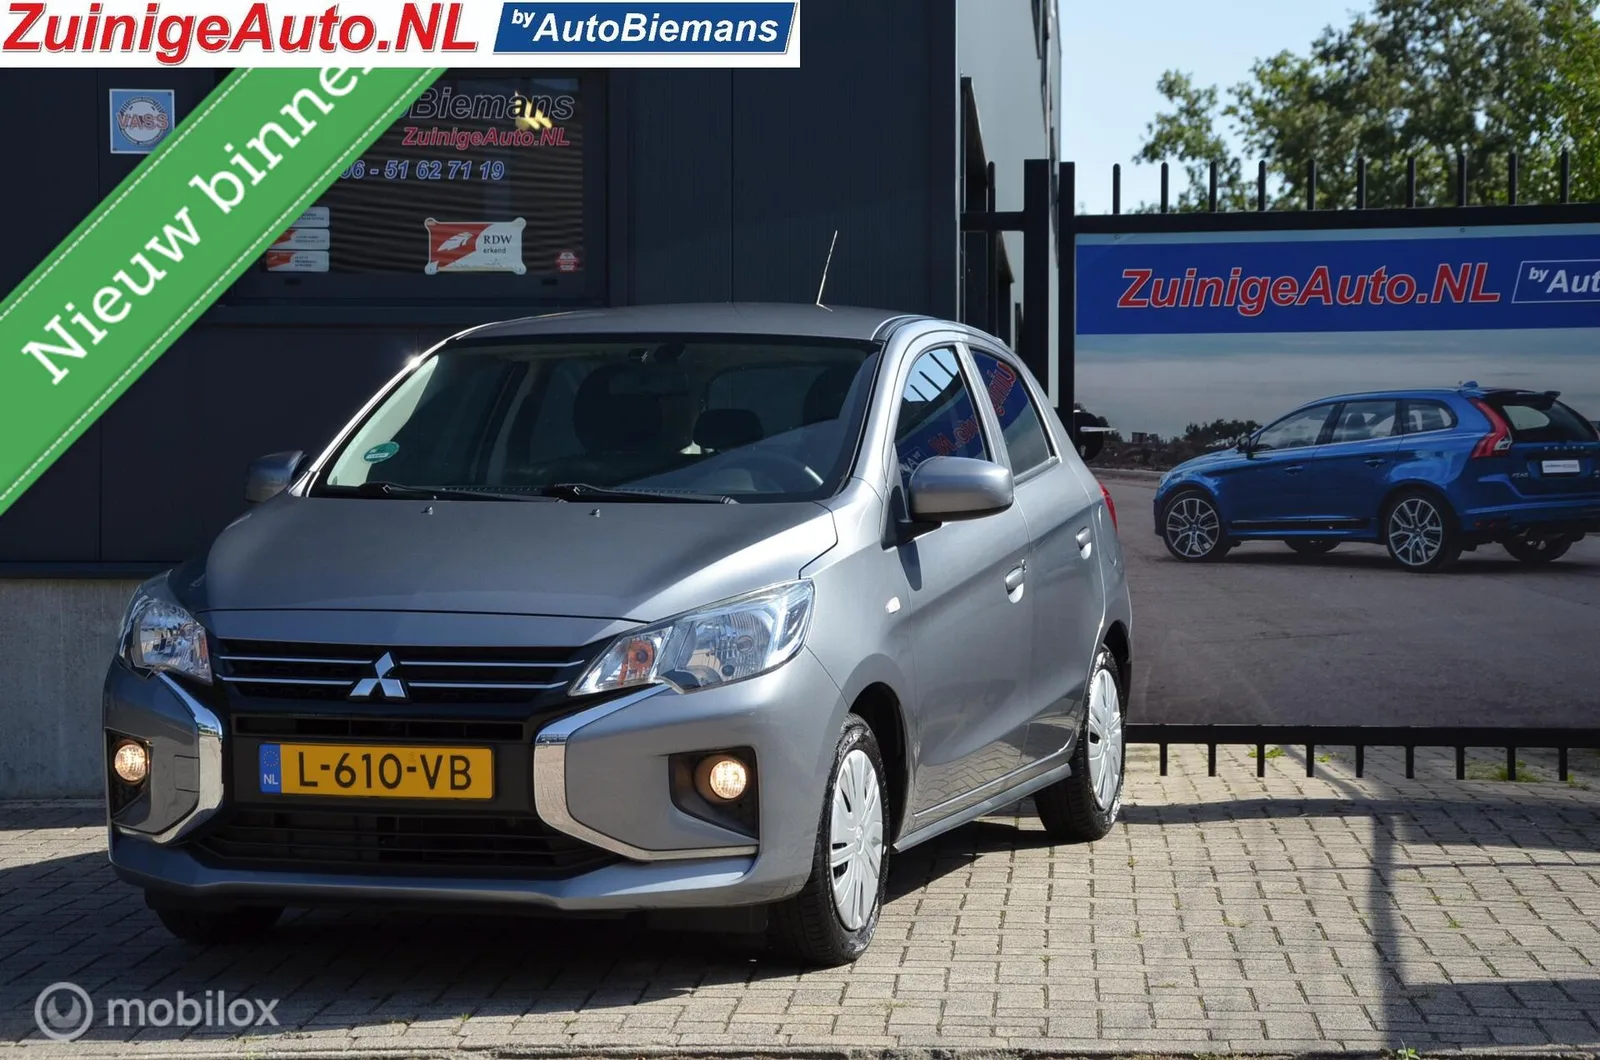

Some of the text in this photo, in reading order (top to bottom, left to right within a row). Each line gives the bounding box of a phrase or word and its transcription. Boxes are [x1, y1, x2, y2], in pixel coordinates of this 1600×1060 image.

[400, 87, 576, 120] Biemans
[116, 112, 169, 130] VASS
[402, 126, 571, 151] ZuinigeAuto.NL
[384, 160, 410, 180] 51
[416, 160, 443, 180] 62
[448, 161, 473, 180] 71
[480, 161, 506, 181] 19
[483, 234, 513, 245] RDW
[1117, 261, 1501, 318] ZuinigeAuto.NL
[1528, 266, 1600, 294] by Aut
[263, 773, 279, 786] NL
[298, 751, 473, 791] L-610-VB
